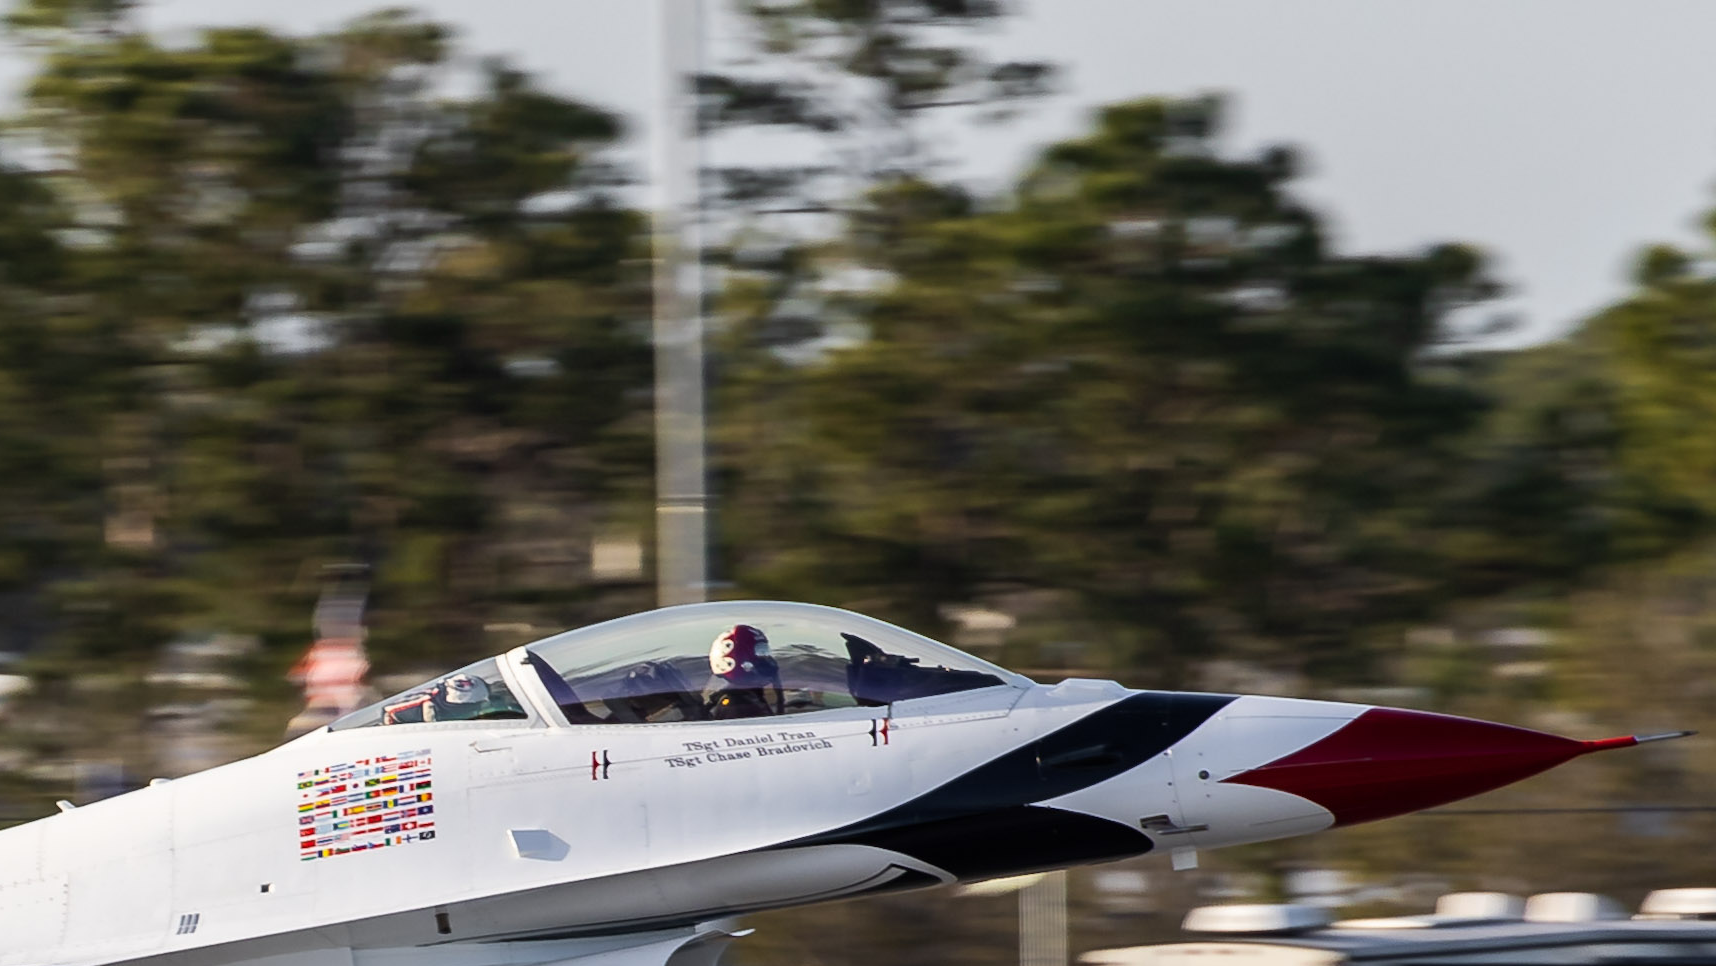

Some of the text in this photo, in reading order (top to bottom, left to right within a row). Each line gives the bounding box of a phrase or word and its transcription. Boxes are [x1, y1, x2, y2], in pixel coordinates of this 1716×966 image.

[664, 738, 833, 768] TSgt Chase Bradovich
[682, 731, 817, 752] TSgt Daniel Tran
